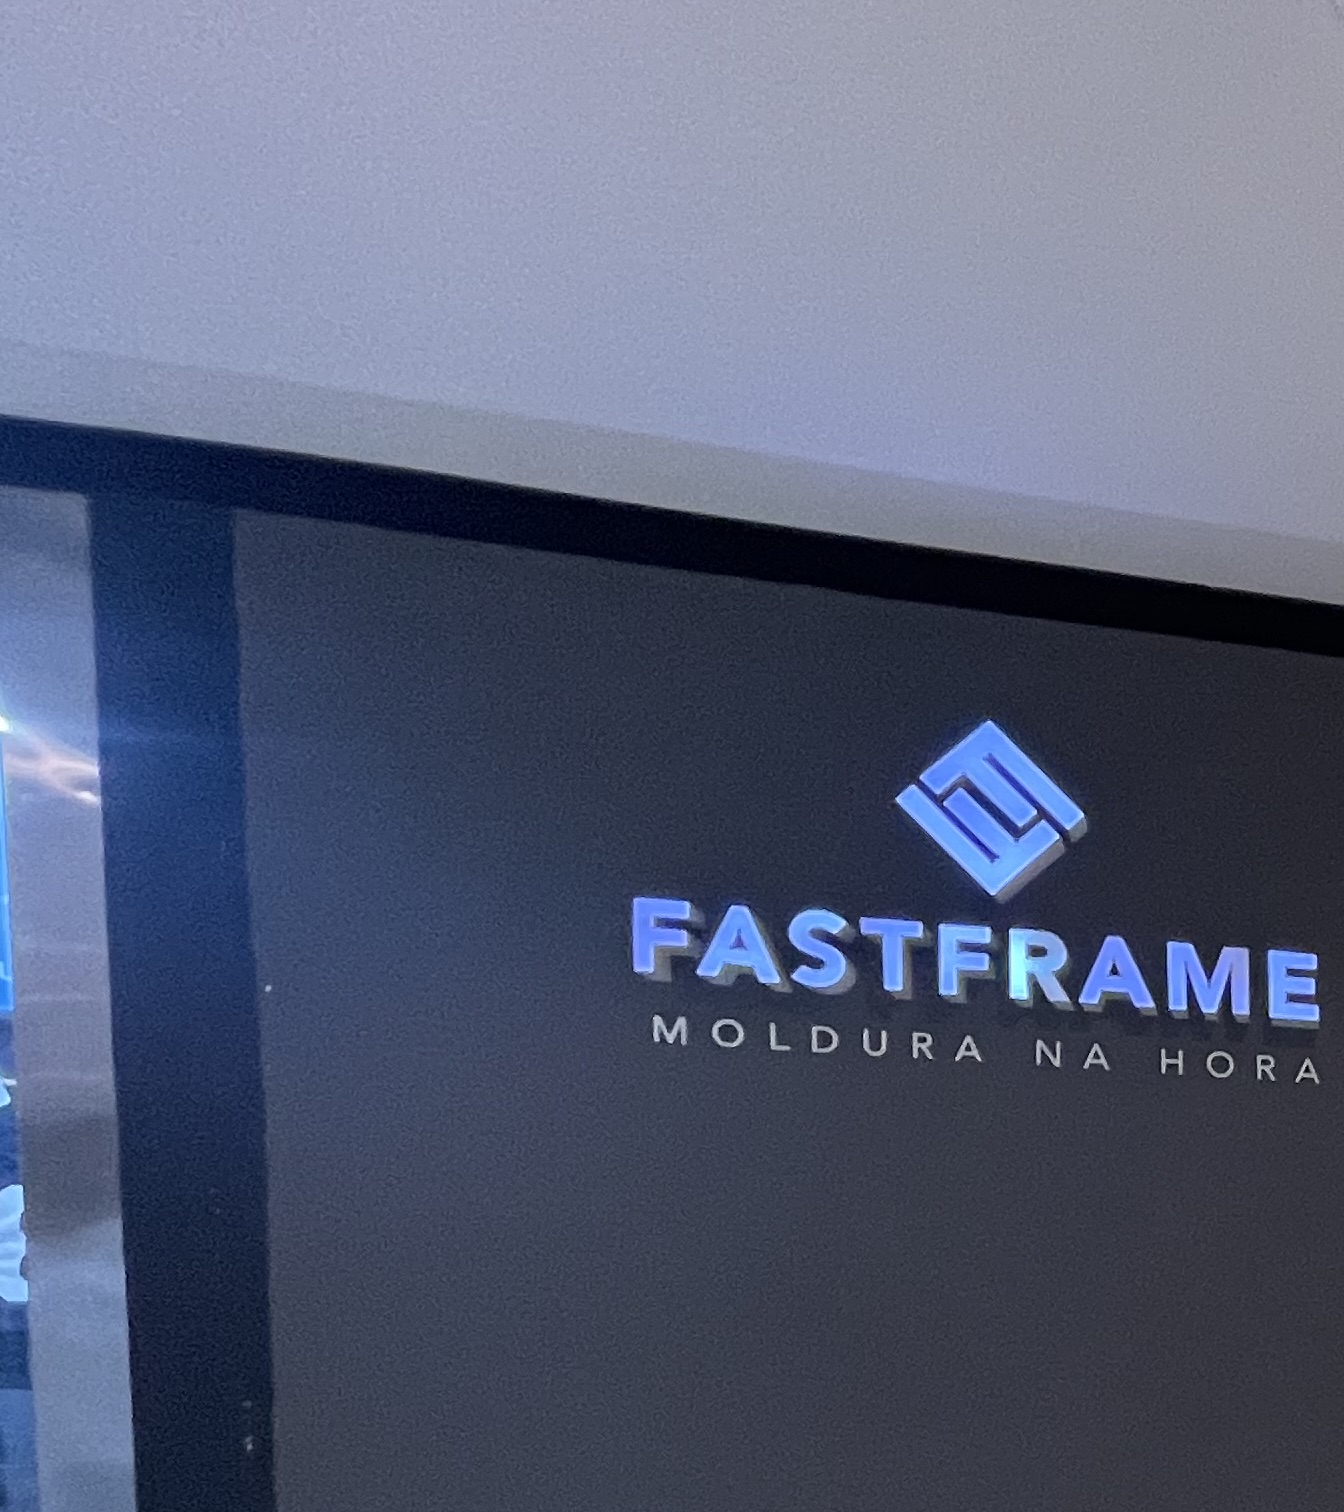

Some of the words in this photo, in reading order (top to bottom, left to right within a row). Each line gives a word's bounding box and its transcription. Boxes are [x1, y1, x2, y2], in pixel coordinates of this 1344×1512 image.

[631, 896, 1322, 1025] FASTFRAME
[651, 1014, 983, 1063] MOLDURA
[1034, 1039, 1111, 1071] NA
[1159, 1048, 1322, 1085] HORA
